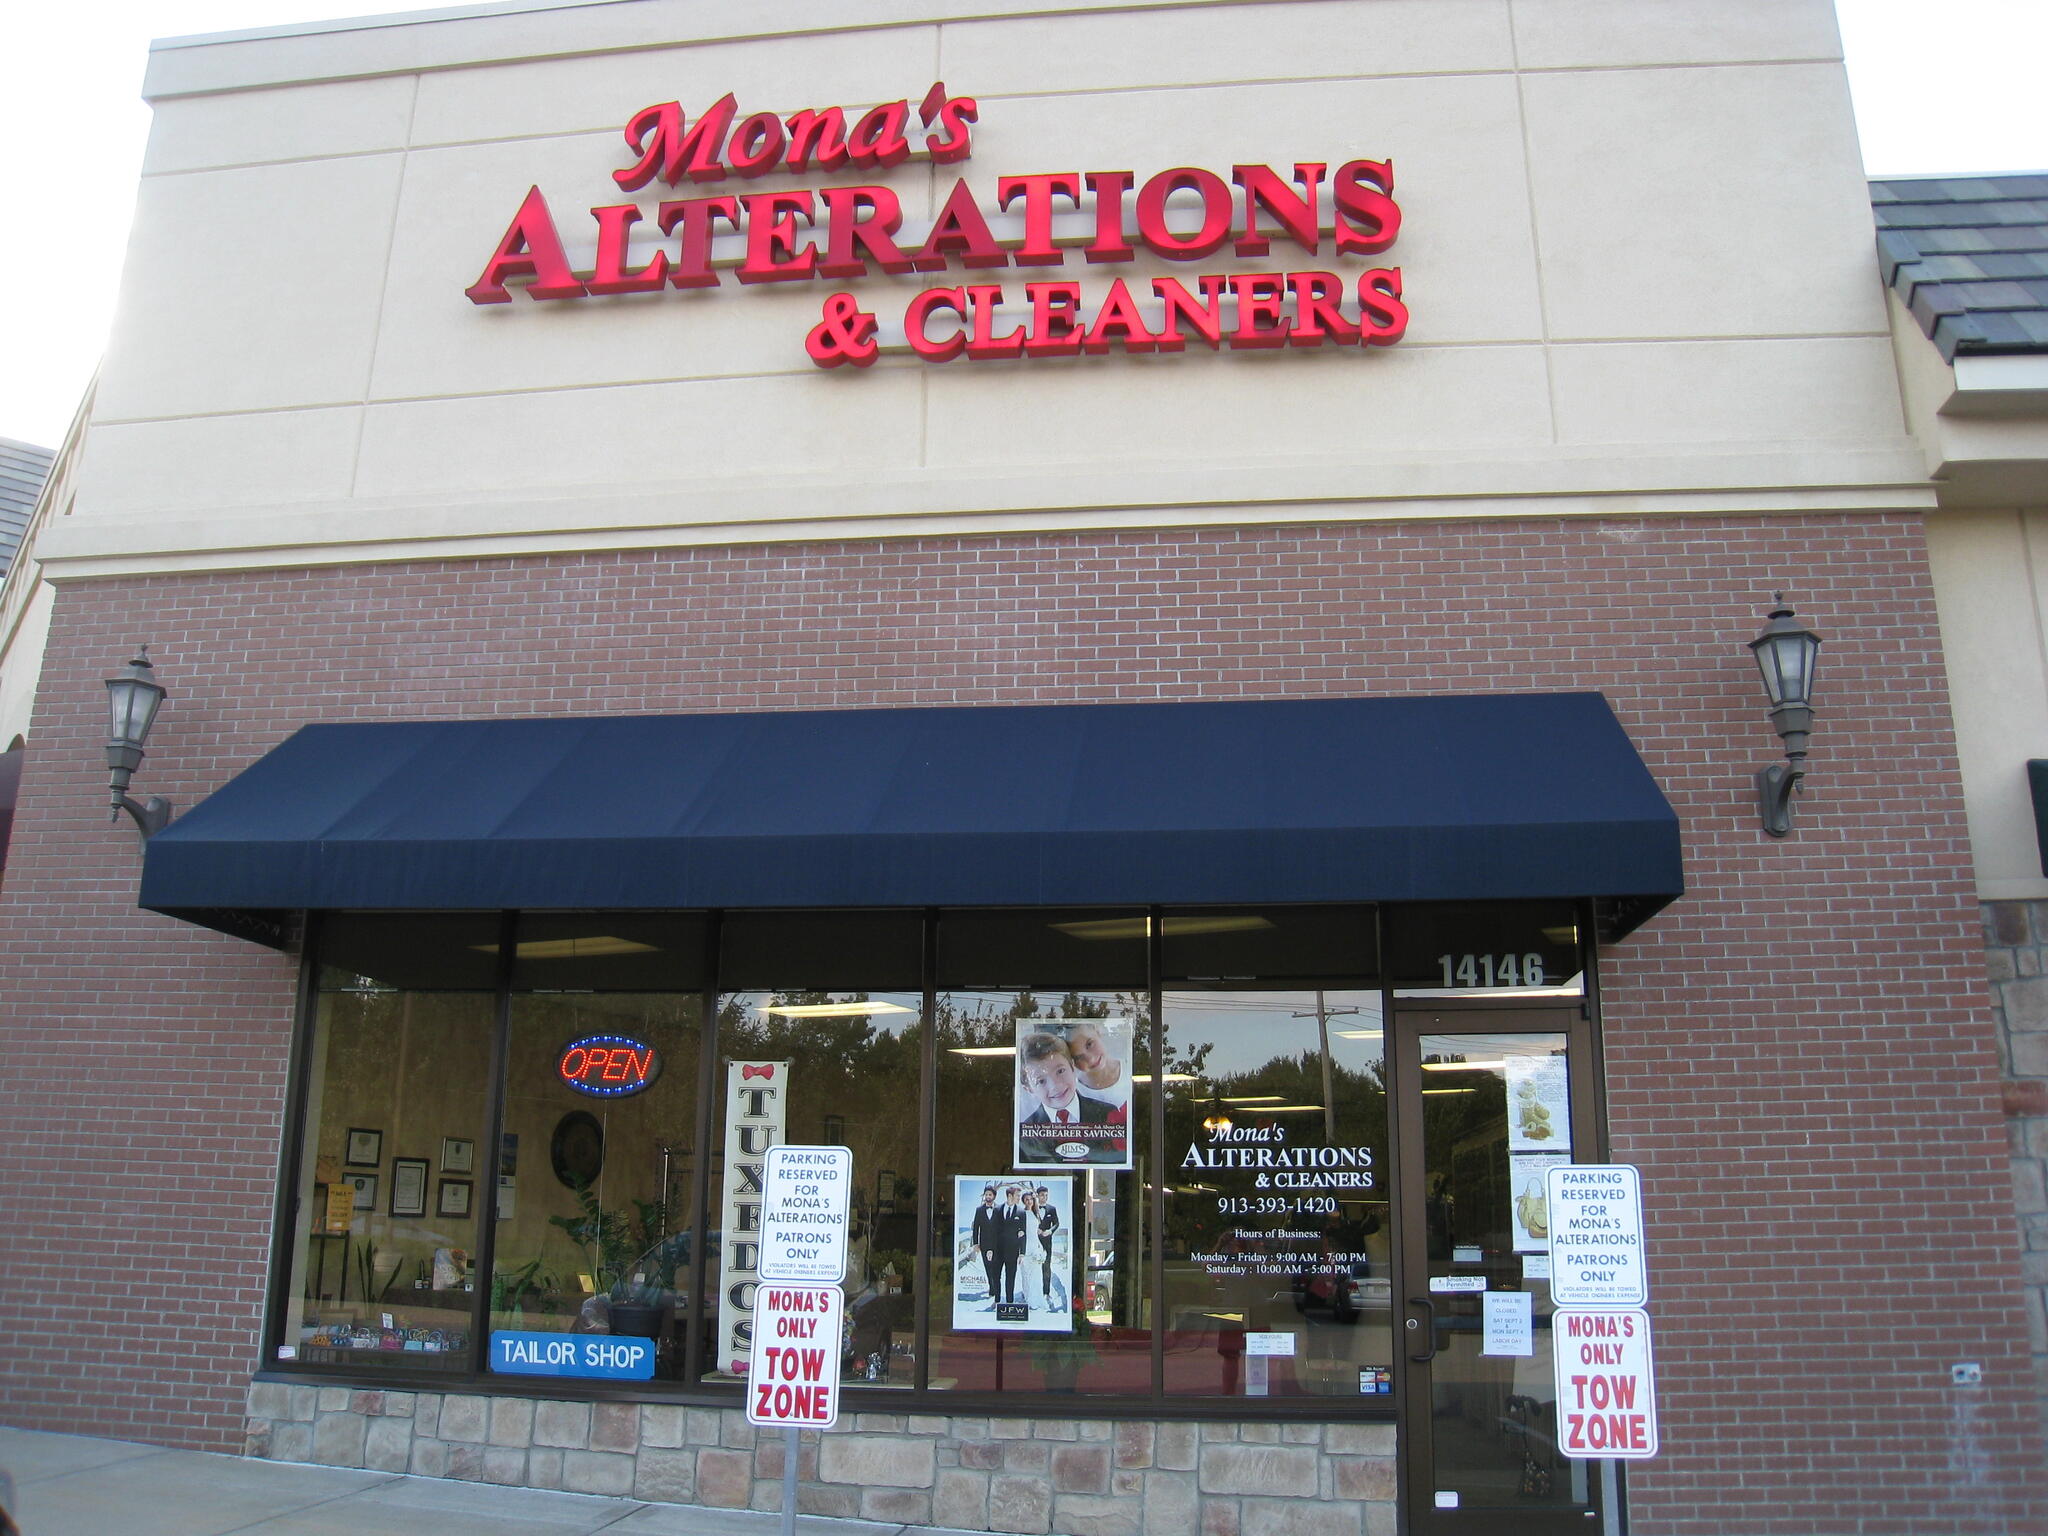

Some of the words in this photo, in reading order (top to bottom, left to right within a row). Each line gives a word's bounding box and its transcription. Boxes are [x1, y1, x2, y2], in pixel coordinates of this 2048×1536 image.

[612, 82, 979, 190] Mona's
[465, 159, 1402, 305] ALTERATIONS
[805, 292, 878, 368] &
[904, 266, 1409, 364] CLEANERS
[1438, 953, 1544, 988] 14146
[560, 1047, 653, 1081] OPEN
[1021, 1129, 1082, 1138] RINGBEARER
[1084, 1129, 1125, 1138] SAVINGS!
[1208, 1121, 1285, 1143] Mona's
[781, 1154, 837, 1165] PARKING
[1180, 1142, 1373, 1168] ALTERATIONS
[778, 1169, 838, 1181] RESERVED
[1254, 1172, 1271, 1188] &
[1274, 1171, 1373, 1188] CLEANERS
[1562, 1173, 1623, 1184] PARKING
[794, 1185, 819, 1196] FOR
[1561, 1189, 1626, 1200] RESERVED
[781, 1197, 830, 1209] MONA'S
[1217, 1197, 1336, 1214] 913-393-1420
[1581, 1205, 1607, 1216] FOR
[767, 1212, 843, 1224] ALTERATIONS
[1569, 1218, 1621, 1229] MONA'S
[775, 1232, 832, 1244] PATRONS
[1235, 1228, 1263, 1239] Hours
[1265, 1228, 1276, 1239] of
[1277, 1228, 1321, 1239] Business:
[1555, 1234, 1637, 1245] ALTERATIONS
[786, 1248, 819, 1259] ONLY
[1190, 1252, 1229, 1264] Monday
[1237, 1252, 1268, 1264] Friday
[1276, 1252, 1297, 1262] 9:00
[1299, 1252, 1317, 1262] AM
[1326, 1252, 1347, 1262] 7:00
[1349, 1252, 1366, 1262] PM
[1567, 1254, 1628, 1266] PATRONS
[1206, 1264, 1247, 1275] Saturday
[1256, 1264, 1282, 1274] 10:00
[1283, 1264, 1302, 1274] AM
[1311, 1264, 1332, 1274] 5:00
[1334, 1264, 1351, 1274] PM
[1580, 1271, 1616, 1282] ONLY
[768, 1290, 829, 1314] MONA'S
[776, 1317, 818, 1339] ONLY
[1567, 1315, 1634, 1338] MONA'S
[501, 1338, 576, 1366] TAILOR
[585, 1342, 645, 1370] SHOP
[1580, 1343, 1624, 1365] ONLY
[765, 1347, 826, 1381] TOW
[1570, 1375, 1637, 1410] TOW
[755, 1384, 829, 1420] ZONE
[1567, 1414, 1648, 1450] ZONE
